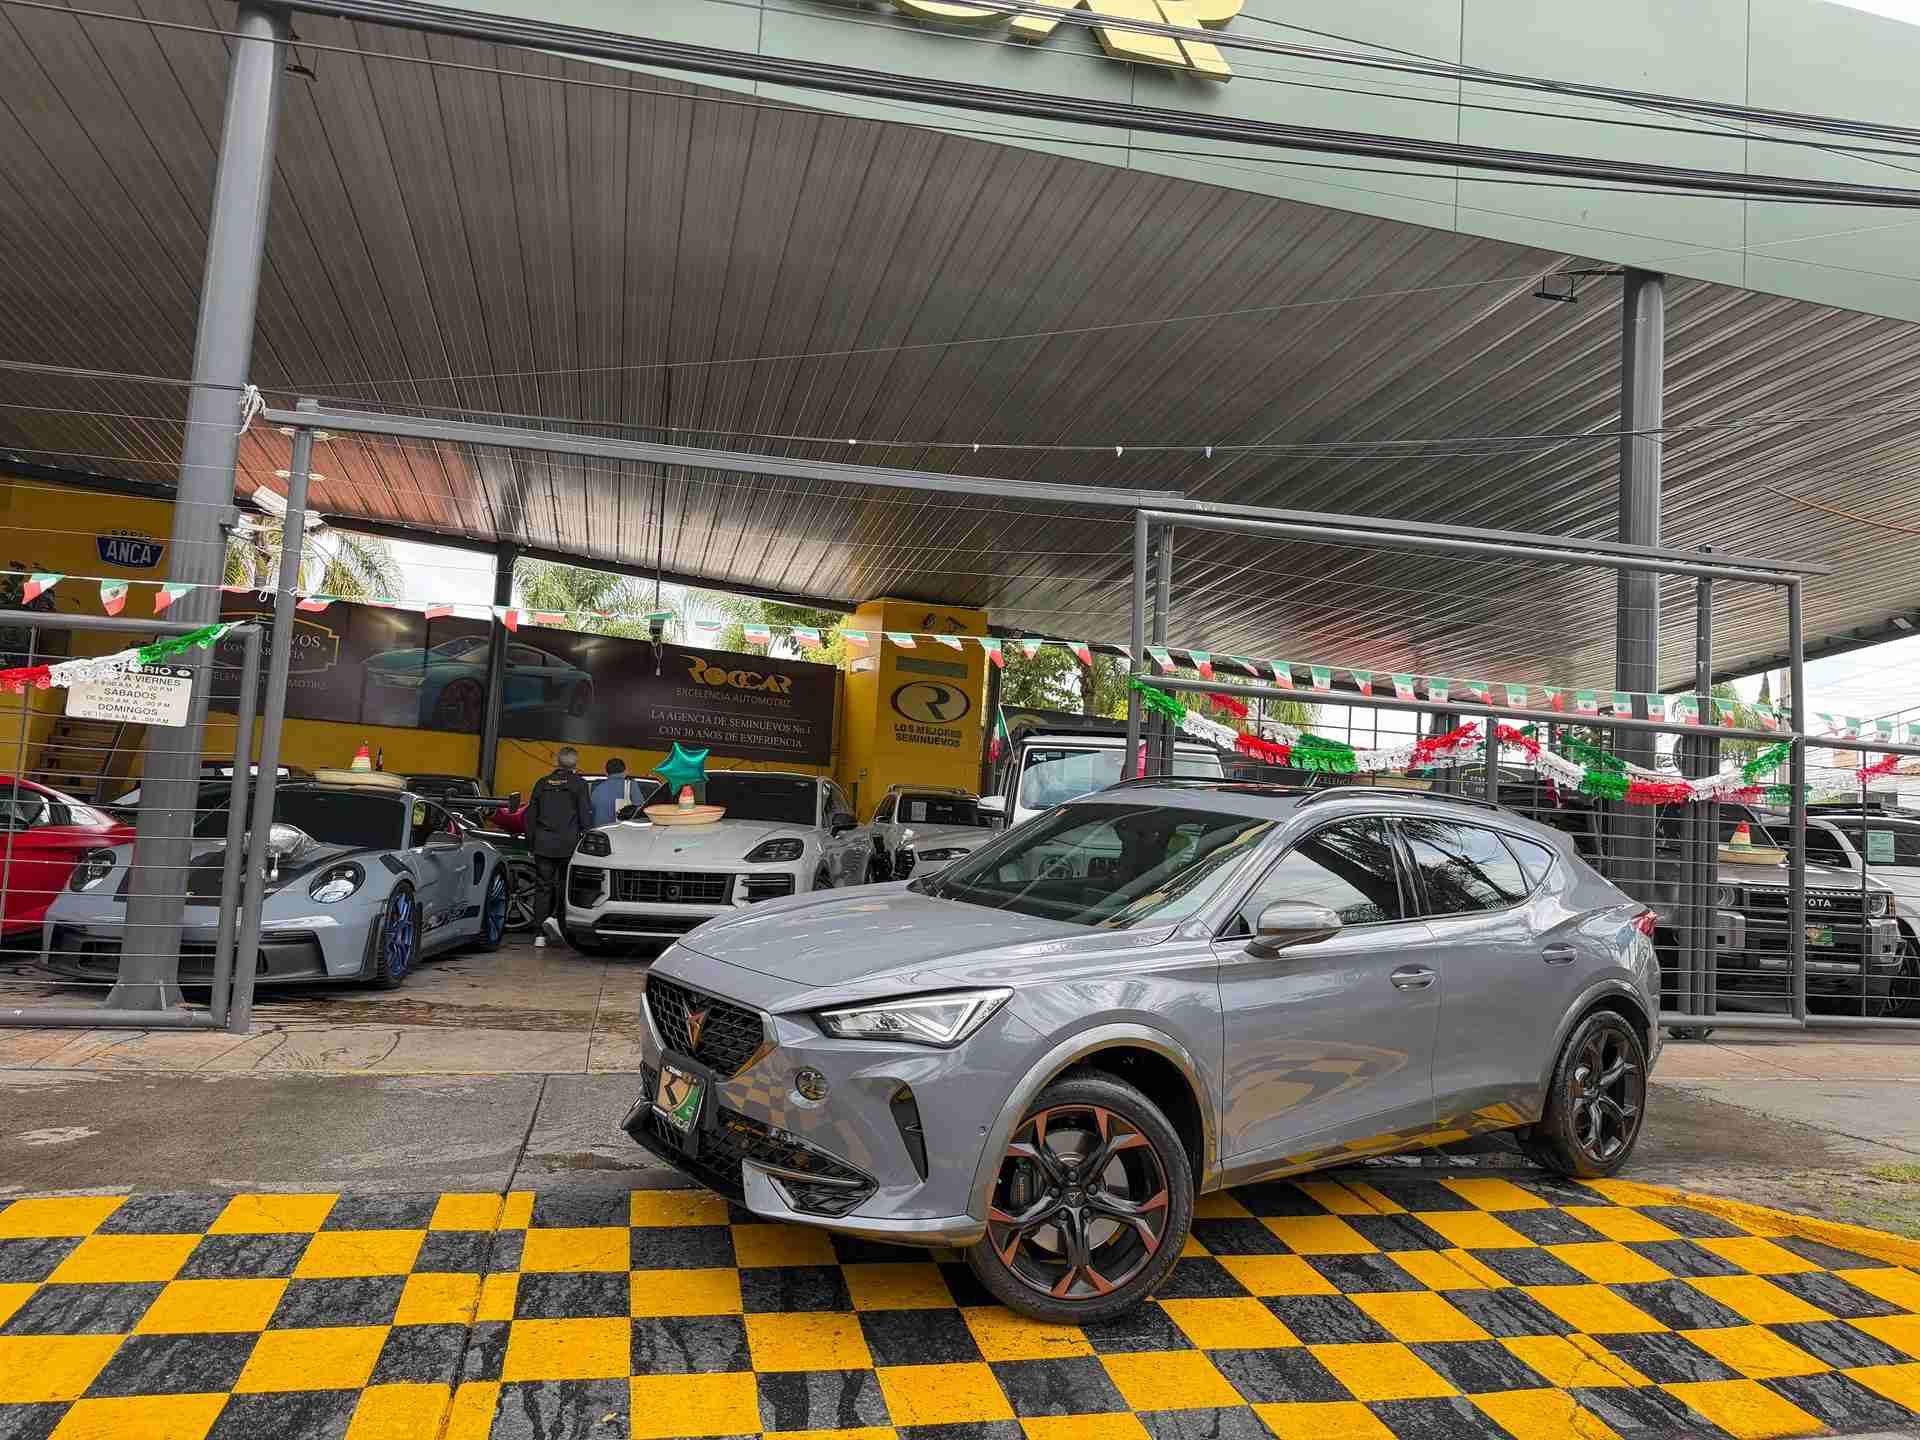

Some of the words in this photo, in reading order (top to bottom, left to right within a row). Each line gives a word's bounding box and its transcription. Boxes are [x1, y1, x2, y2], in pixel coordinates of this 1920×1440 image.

[106, 541, 152, 563] ANCA
[135, 675, 181, 687] VIERNES
[680, 654, 792, 695] ROCCAR
[103, 687, 157, 700] SABADOS
[97, 703, 158, 716] DOMINGOS
[650, 708, 665, 721] LA
[665, 711, 712, 725] AGENCIA
[714, 715, 728, 727] DE
[729, 718, 792, 734] SEMINUEVOS
[658, 725, 681, 736] CON
[725, 733, 738, 743] DE
[740, 733, 802, 749] EXPERIENCIA
[895, 731, 961, 747] SEMINUEVOS
[1784, 896, 1831, 908] TOTA
